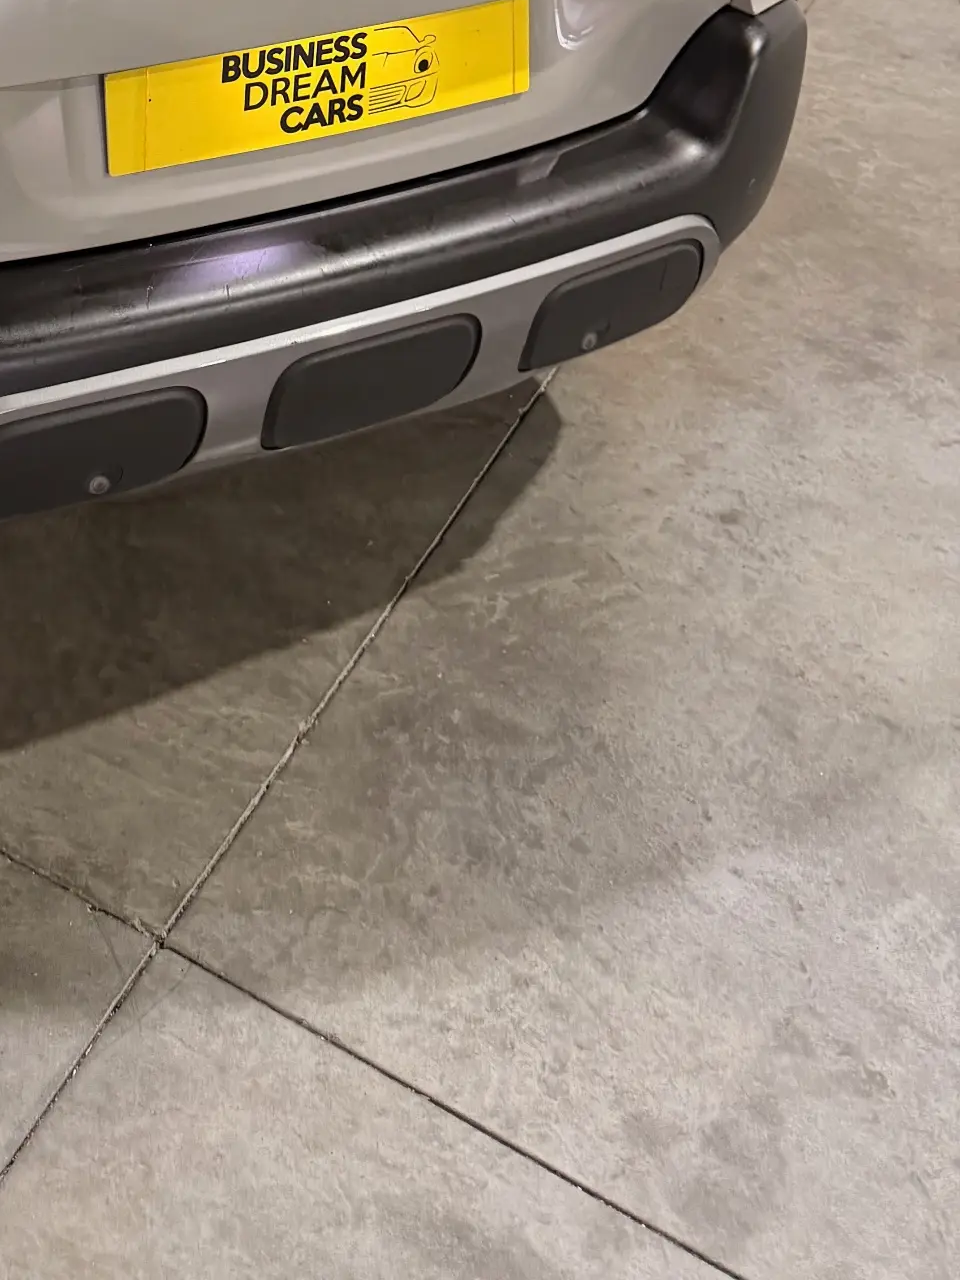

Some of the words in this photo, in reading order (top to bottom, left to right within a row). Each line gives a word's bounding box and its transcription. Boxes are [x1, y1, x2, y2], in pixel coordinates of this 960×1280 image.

[221, 32, 368, 84] BUSINESS
[244, 62, 367, 112] DREAM
[279, 94, 364, 134] CARS
